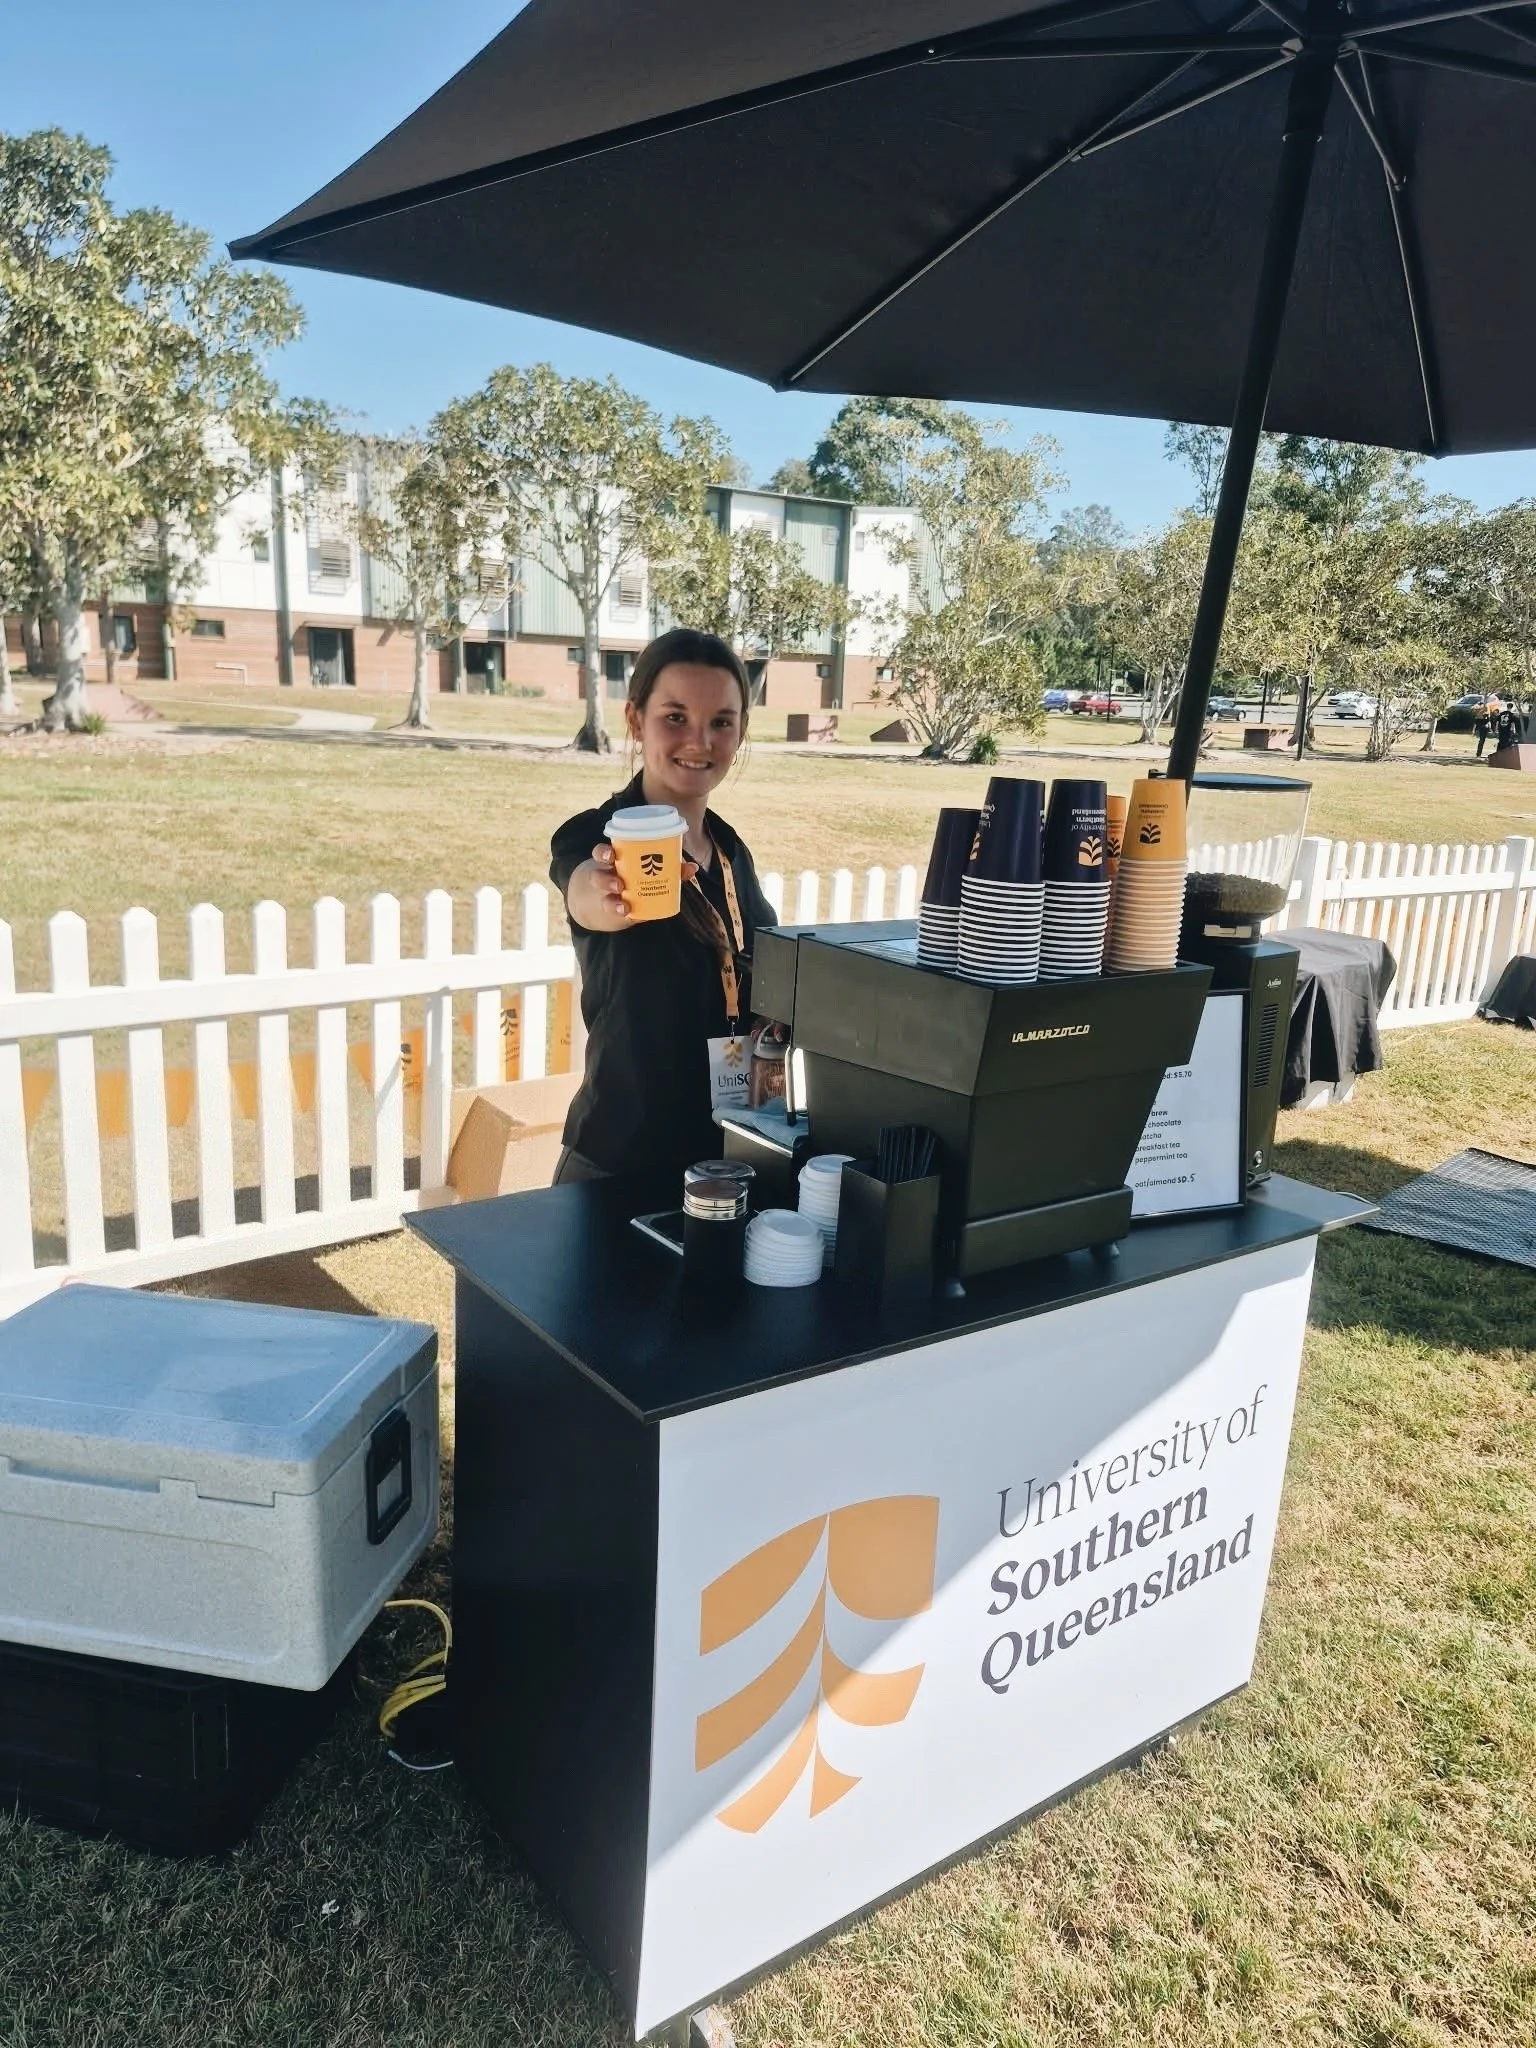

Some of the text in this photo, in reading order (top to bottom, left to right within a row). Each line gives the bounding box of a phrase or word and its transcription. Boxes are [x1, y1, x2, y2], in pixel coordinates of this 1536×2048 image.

[1012, 1032, 1024, 1043] LA
[1147, 1119, 1182, 1129] chocolate
[1140, 1133, 1162, 1141] atcha
[1135, 1153, 1175, 1164] peppermint
[997, 1384, 1268, 1539] University of
[987, 1486, 1208, 1616] Southern
[981, 1513, 1254, 1695] Queensland
